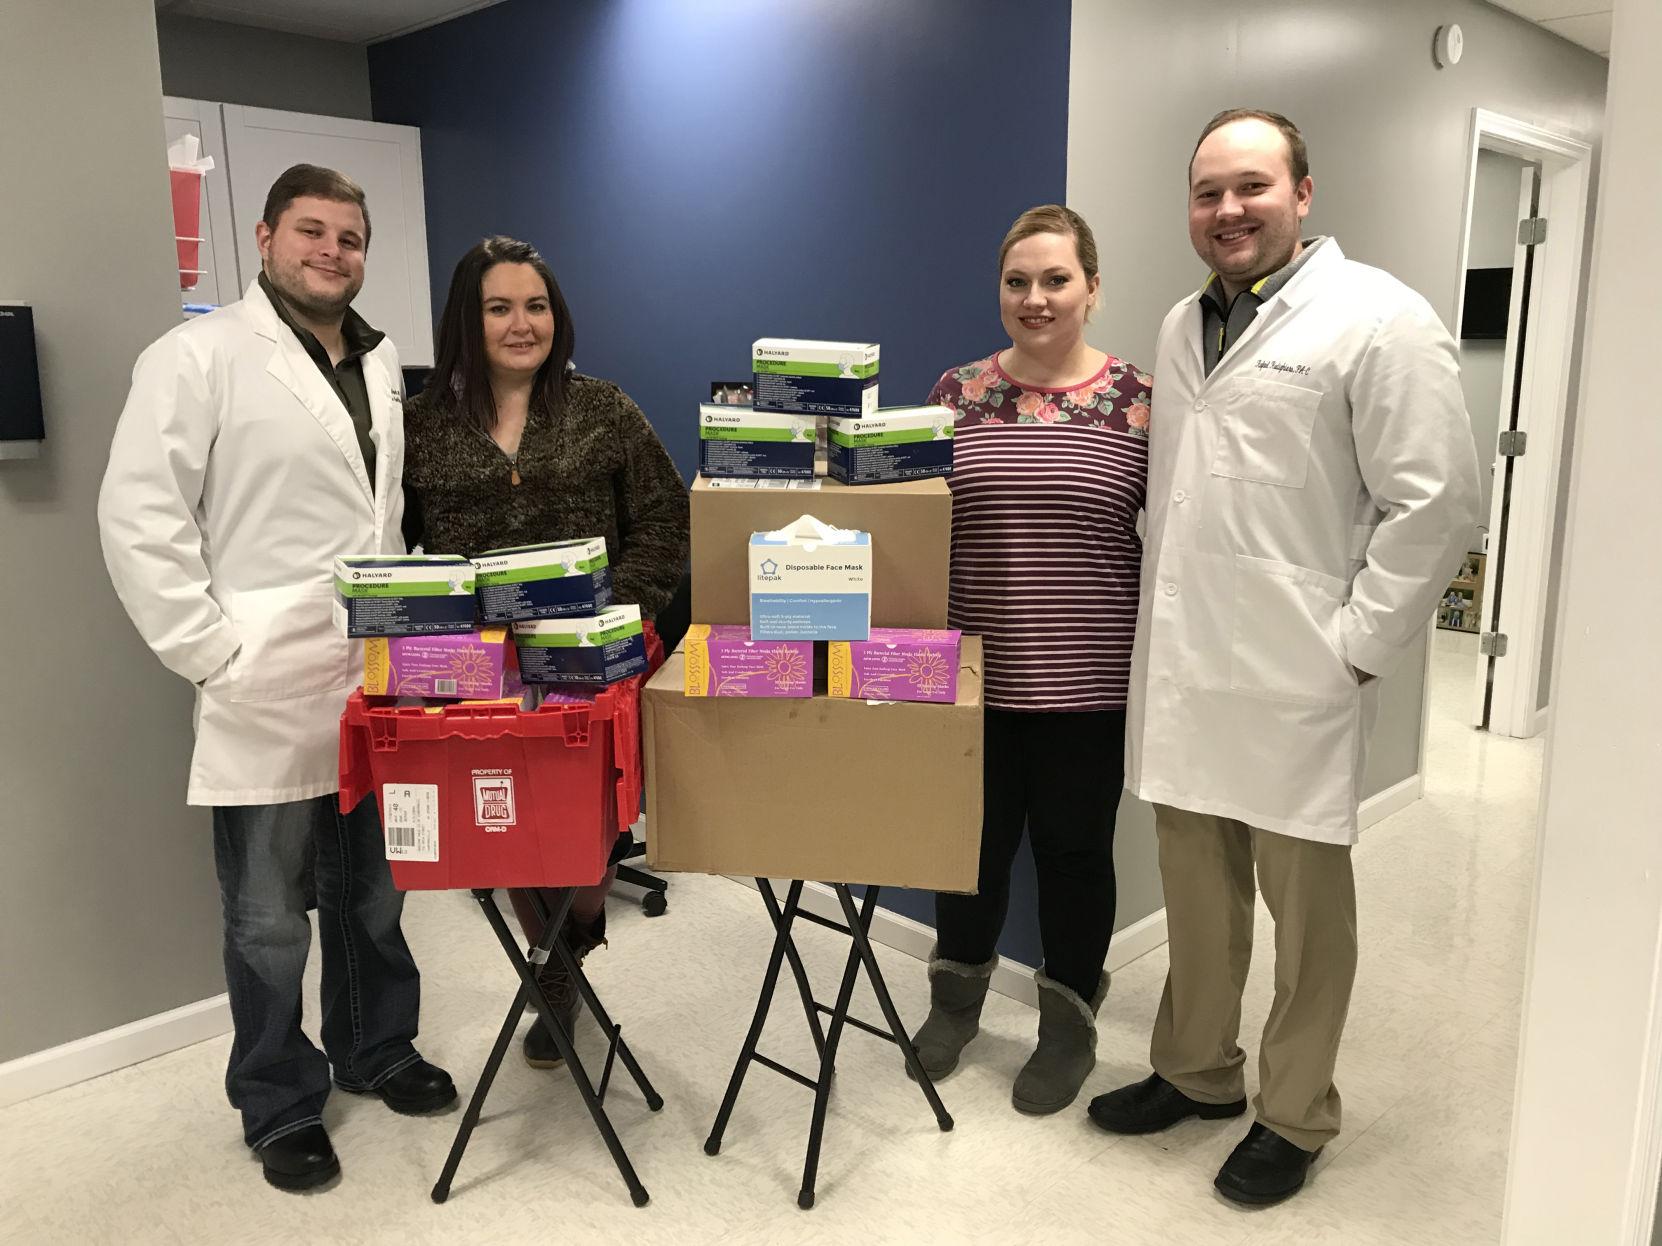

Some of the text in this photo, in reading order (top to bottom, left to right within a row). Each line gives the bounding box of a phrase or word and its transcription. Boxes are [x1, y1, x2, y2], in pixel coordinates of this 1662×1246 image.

[604, 614, 625, 624] HALYARD
[600, 625, 625, 636] PROCEDURE
[367, 638, 380, 693] BLOSSOM
[688, 641, 700, 695] BLOSSOM
[832, 643, 843, 695] BLOSSOM
[482, 788, 506, 802] MUTUAL
[485, 804, 508, 818] DRUG
